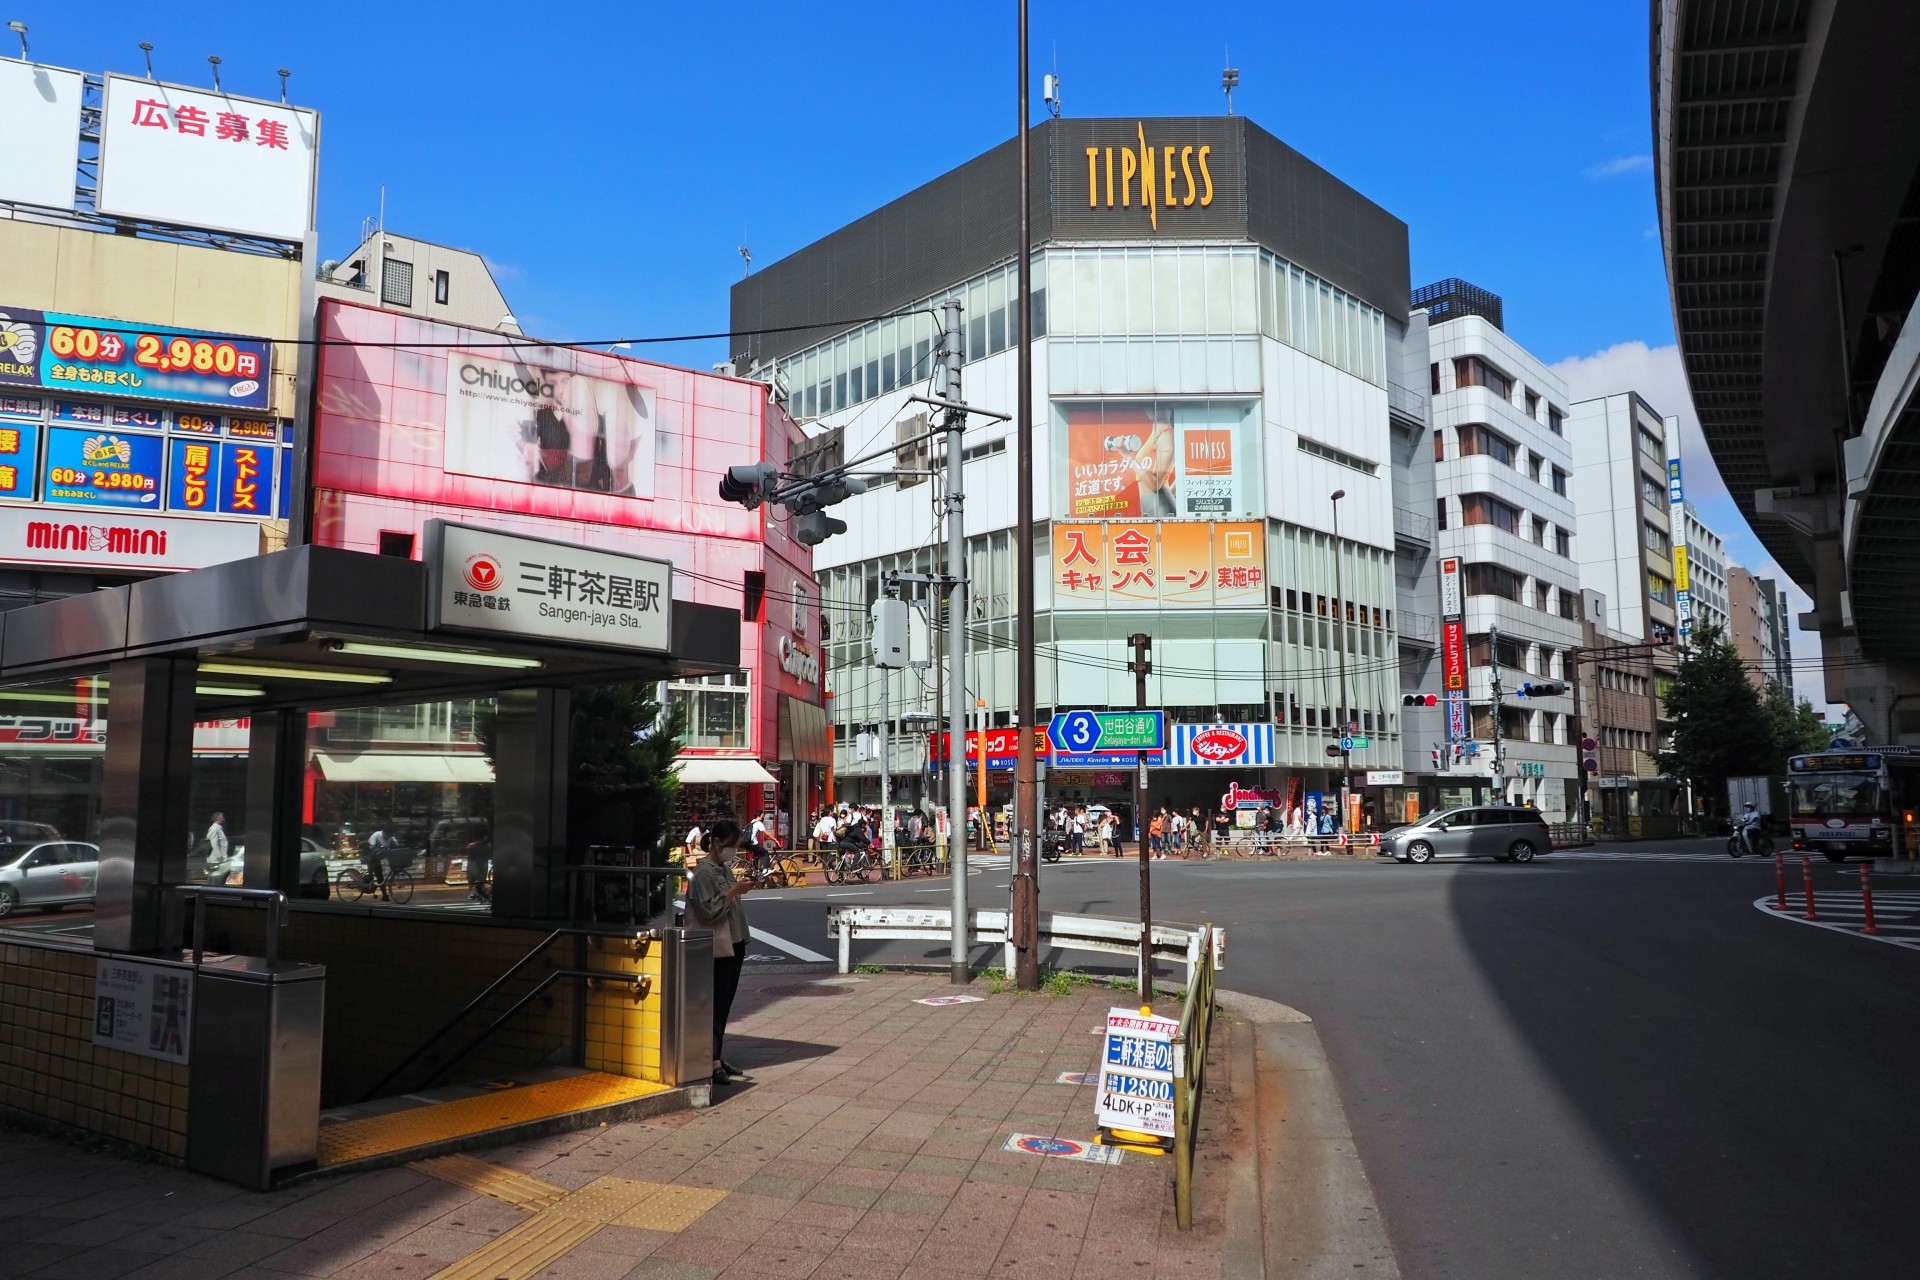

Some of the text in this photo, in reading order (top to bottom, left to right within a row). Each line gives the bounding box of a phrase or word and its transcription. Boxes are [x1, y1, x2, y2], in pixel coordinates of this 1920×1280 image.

[131, 98, 290, 151] 広告募集
[1086, 121, 1213, 231] TIPNESS
[50, 325, 122, 358] 60分
[136, 335, 257, 375] 2,980円
[51, 363, 143, 388] 全身もみほぐし
[459, 364, 555, 399] Chiyoda
[71, 406, 102, 420] 本格
[115, 410, 158, 426] ほぐし
[179, 415, 215, 432] 60分
[231, 420, 274, 437] 2,980円
[1190, 434, 1226, 460] TIPNESS
[51, 468, 154, 489] 60分 2,980円
[185, 445, 209, 507] 肩こり
[233, 449, 257, 508] ストレス
[1075, 456, 1153, 478] いいカラダへの
[1075, 476, 1126, 497] 近道です。
[1185, 488, 1233, 497] ティップネス
[27, 521, 167, 556] mini mini
[1062, 529, 1151, 567] 入会
[517, 561, 660, 614] 三軒茶屋駅
[1062, 565, 1263, 592] キャンペーン 実施中
[453, 591, 511, 612] 東急電鉄
[538, 602, 642, 629] Sangen-jaya Sta.
[1072, 717, 1090, 745] 3
[1104, 717, 1155, 735] 世田谷通り
[1103, 735, 1155, 747] Setagaya-dori Ave.
[1346, 739, 1352, 748] 3
[1000, 757, 1014, 766] KOSÉ
[1118, 1076, 1170, 1101] 12800
[1102, 1093, 1152, 1116] 4LDK+P
